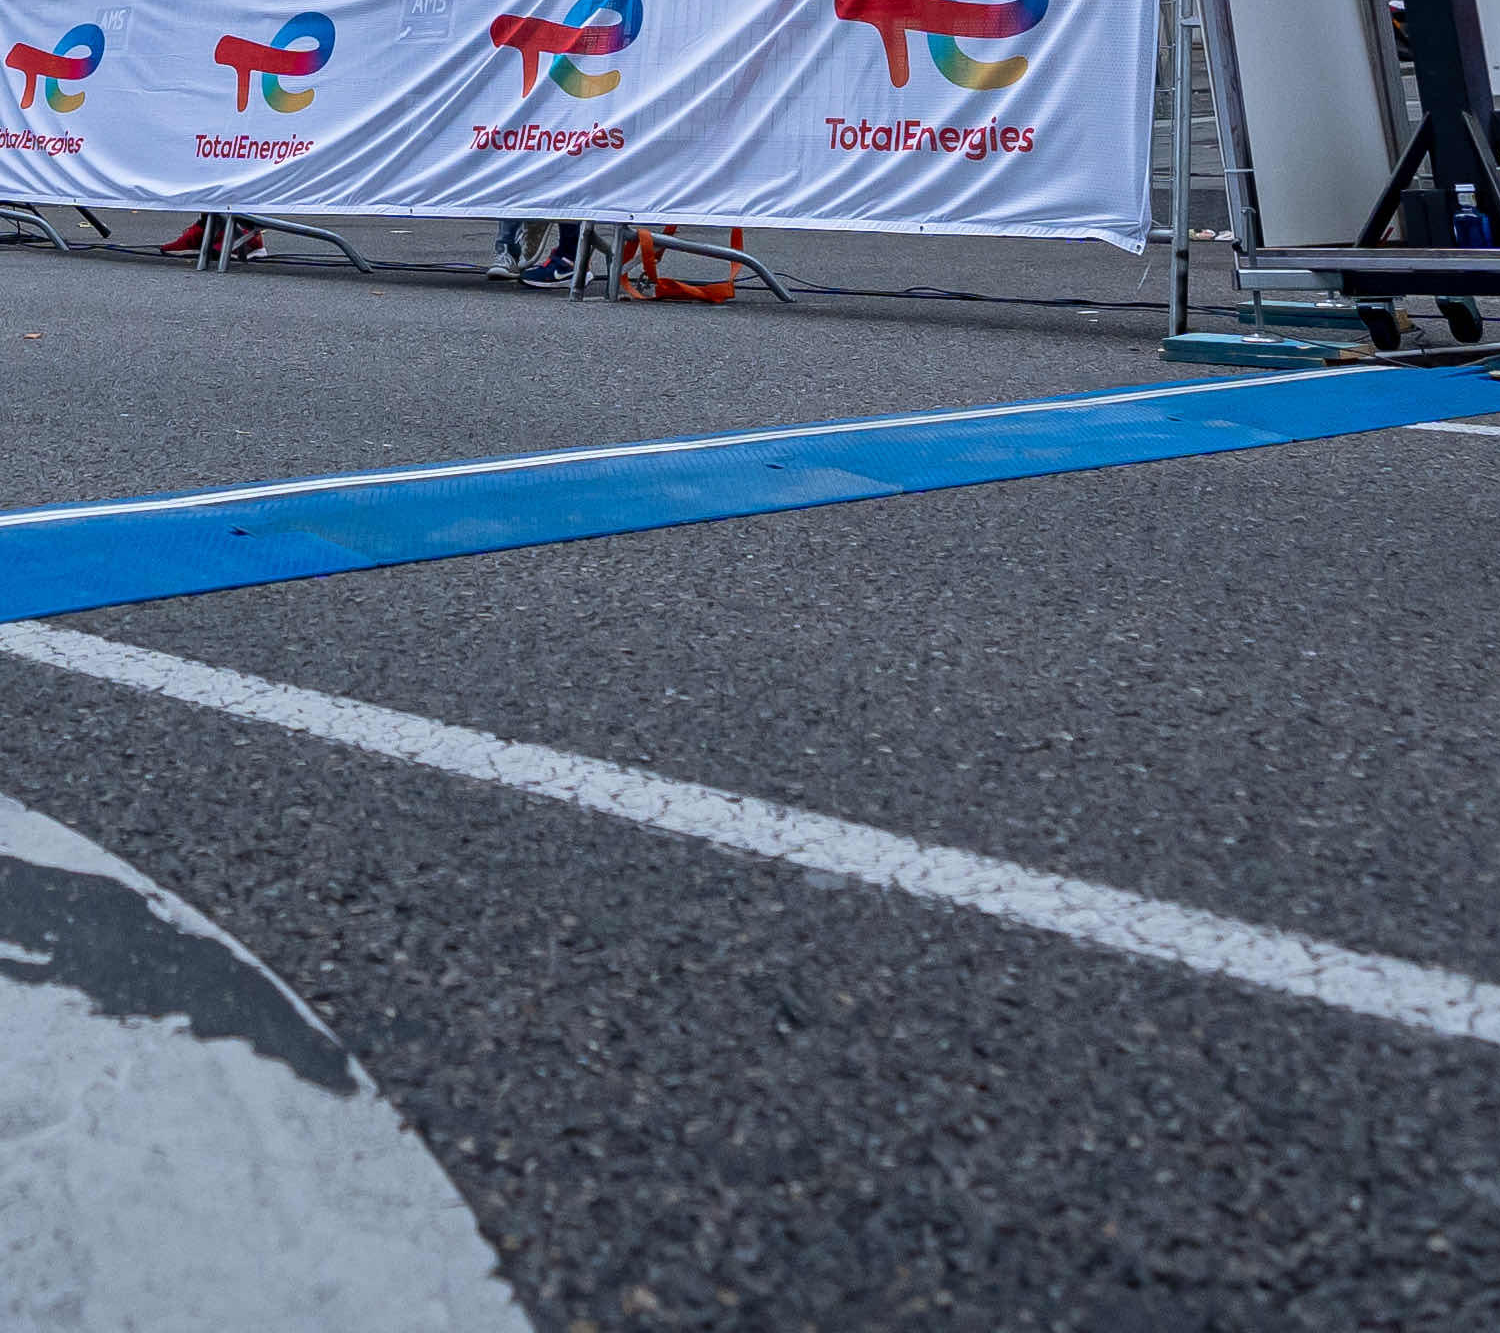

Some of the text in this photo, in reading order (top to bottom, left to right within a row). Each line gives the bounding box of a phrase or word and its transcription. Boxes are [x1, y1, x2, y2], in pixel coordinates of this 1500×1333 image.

[194, 133, 315, 166] TotalEnergies
[470, 121, 626, 157] TotalEnergies
[825, 115, 1034, 162] TotalEnergies
